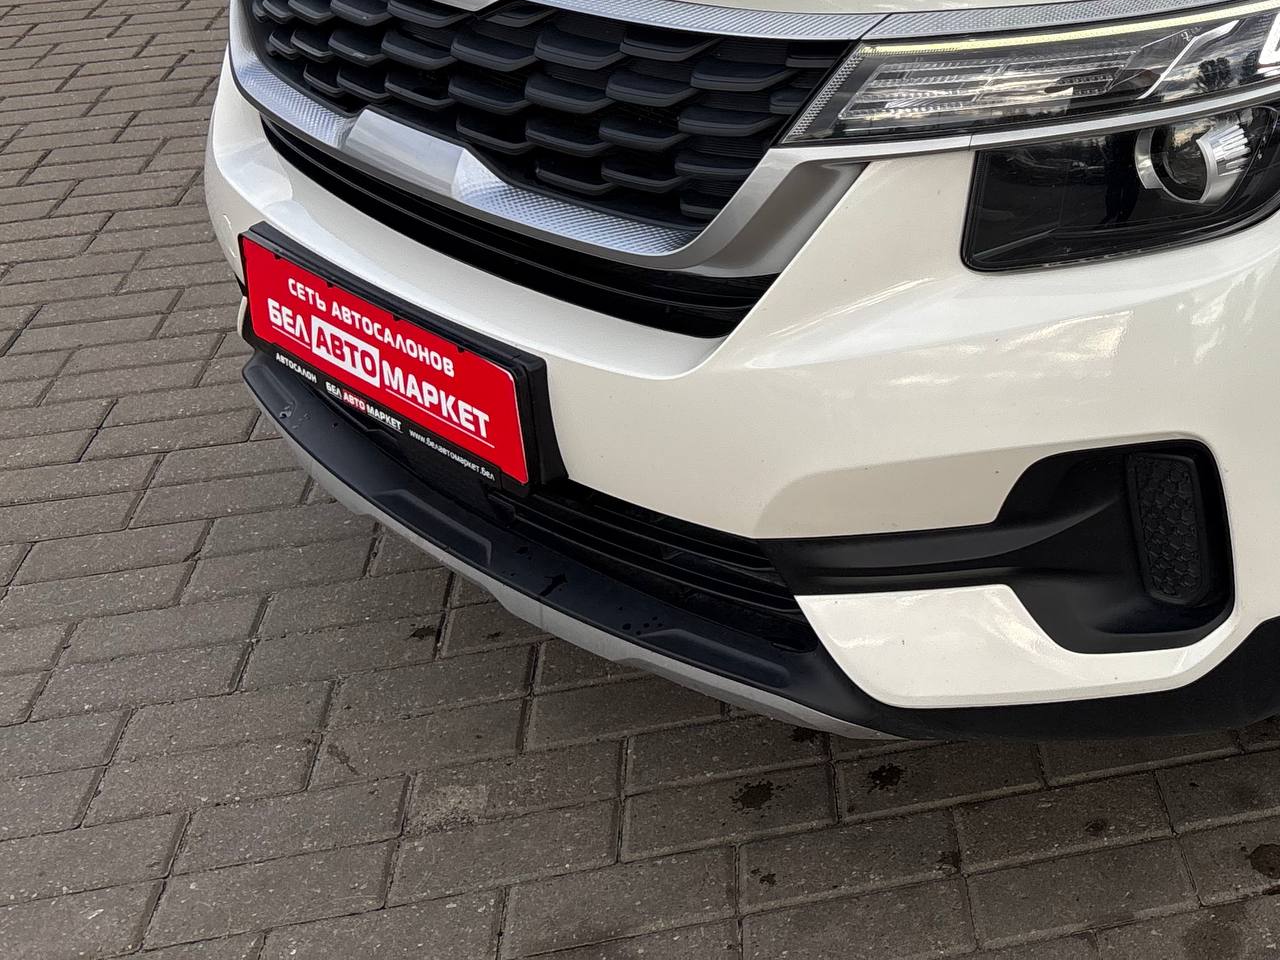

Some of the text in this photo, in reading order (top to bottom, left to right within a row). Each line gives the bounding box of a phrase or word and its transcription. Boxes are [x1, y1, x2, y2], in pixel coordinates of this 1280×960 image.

[267, 297, 490, 439] БЕЛ АВТО МАРКЕТ
[275, 352, 318, 384] АВТОСАЛОН
[288, 277, 455, 378] СЕТЬ АВТОСАЛОНОВ
